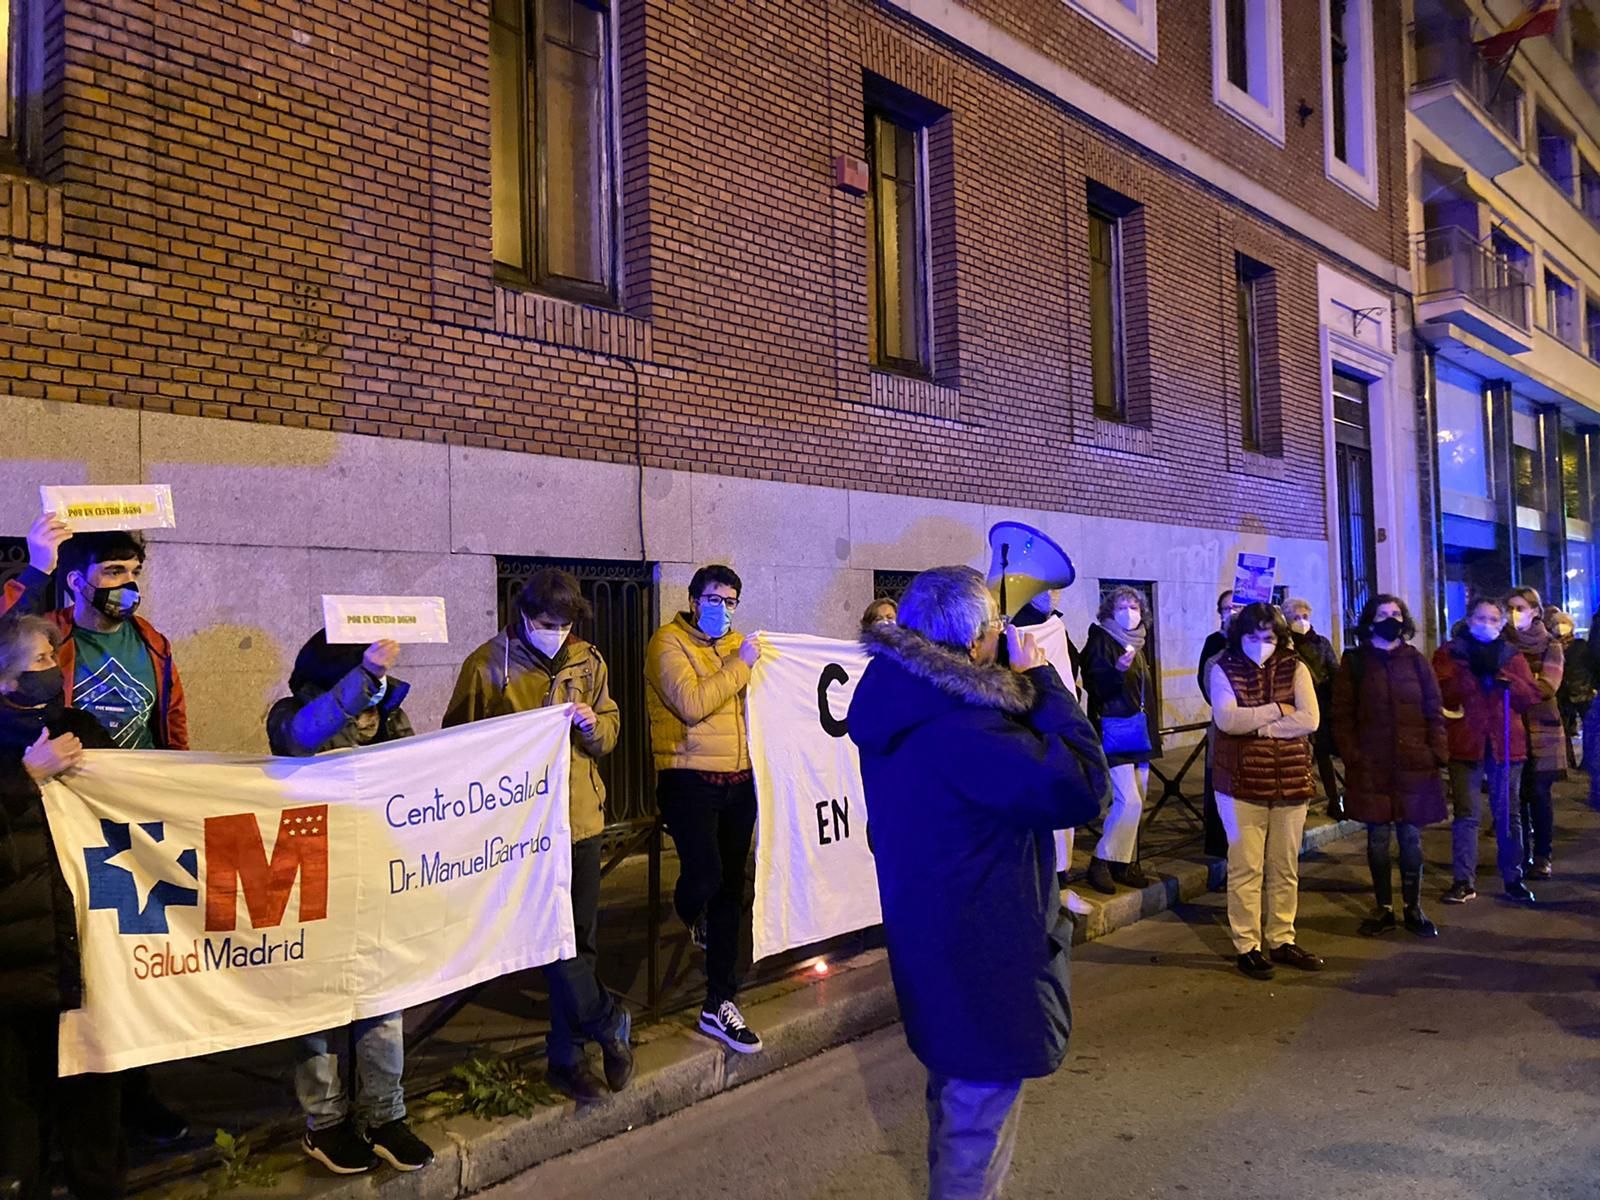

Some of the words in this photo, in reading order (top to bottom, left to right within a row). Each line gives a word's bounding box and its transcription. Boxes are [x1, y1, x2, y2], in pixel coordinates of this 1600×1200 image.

[68, 508, 83, 517] POR
[347, 615, 361, 624] POR
[386, 788, 466, 828] Centro
[468, 781, 497, 814] De
[499, 764, 549, 807] Salud
[815, 796, 850, 845] EN
[389, 859, 418, 894] Dr.
[421, 840, 488, 888] Manuel
[133, 939, 201, 980] Salud
[203, 928, 305, 971] Madrid
